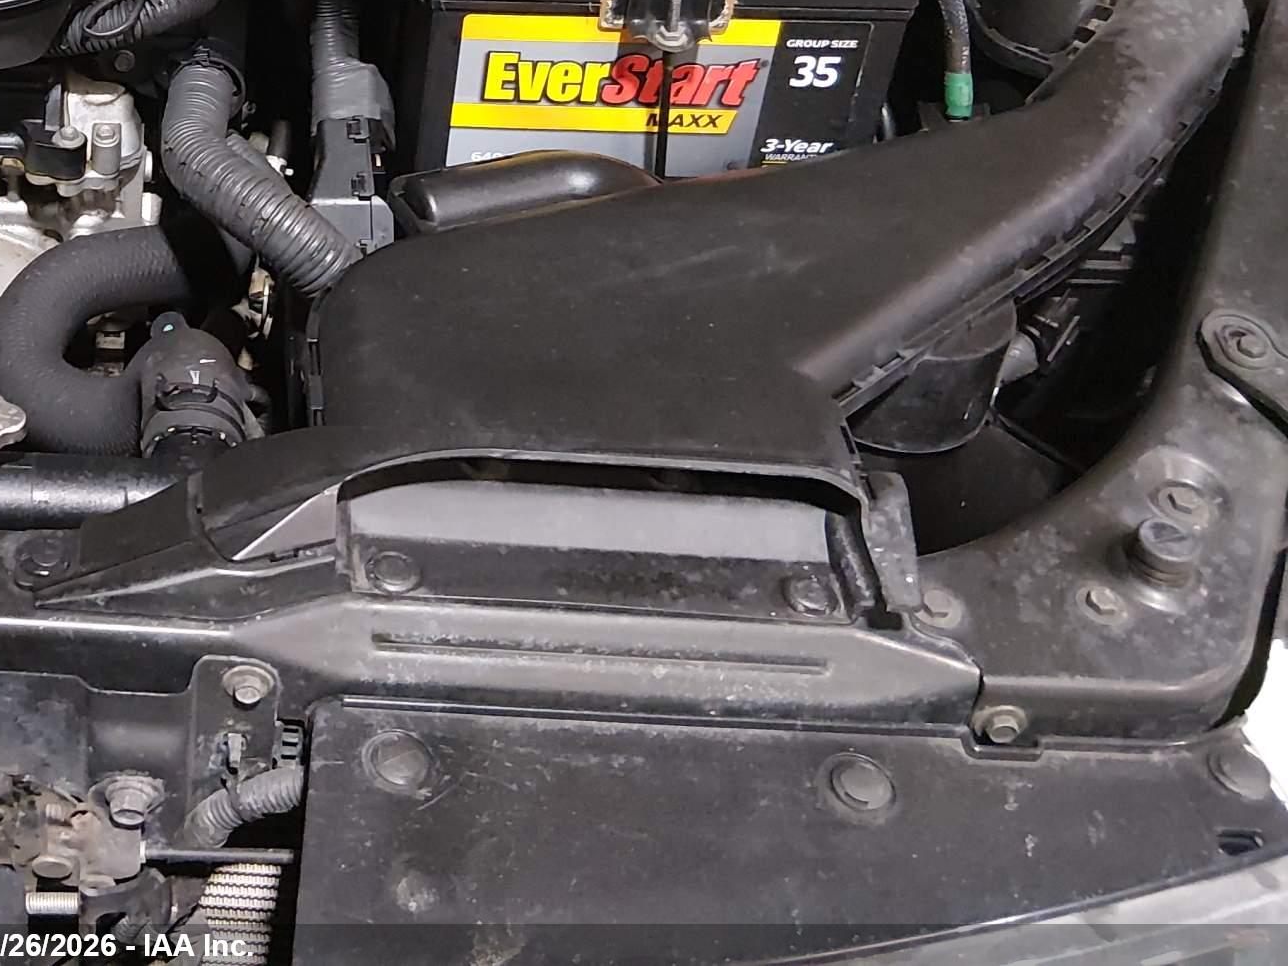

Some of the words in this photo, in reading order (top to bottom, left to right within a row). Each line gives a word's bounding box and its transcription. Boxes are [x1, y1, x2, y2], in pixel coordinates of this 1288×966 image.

[786, 38, 830, 48] GROUP
[830, 39, 859, 49] SIZE
[482, 50, 761, 108] EverStart
[788, 54, 842, 88] 35
[760, 137, 835, 154] 3-Year
